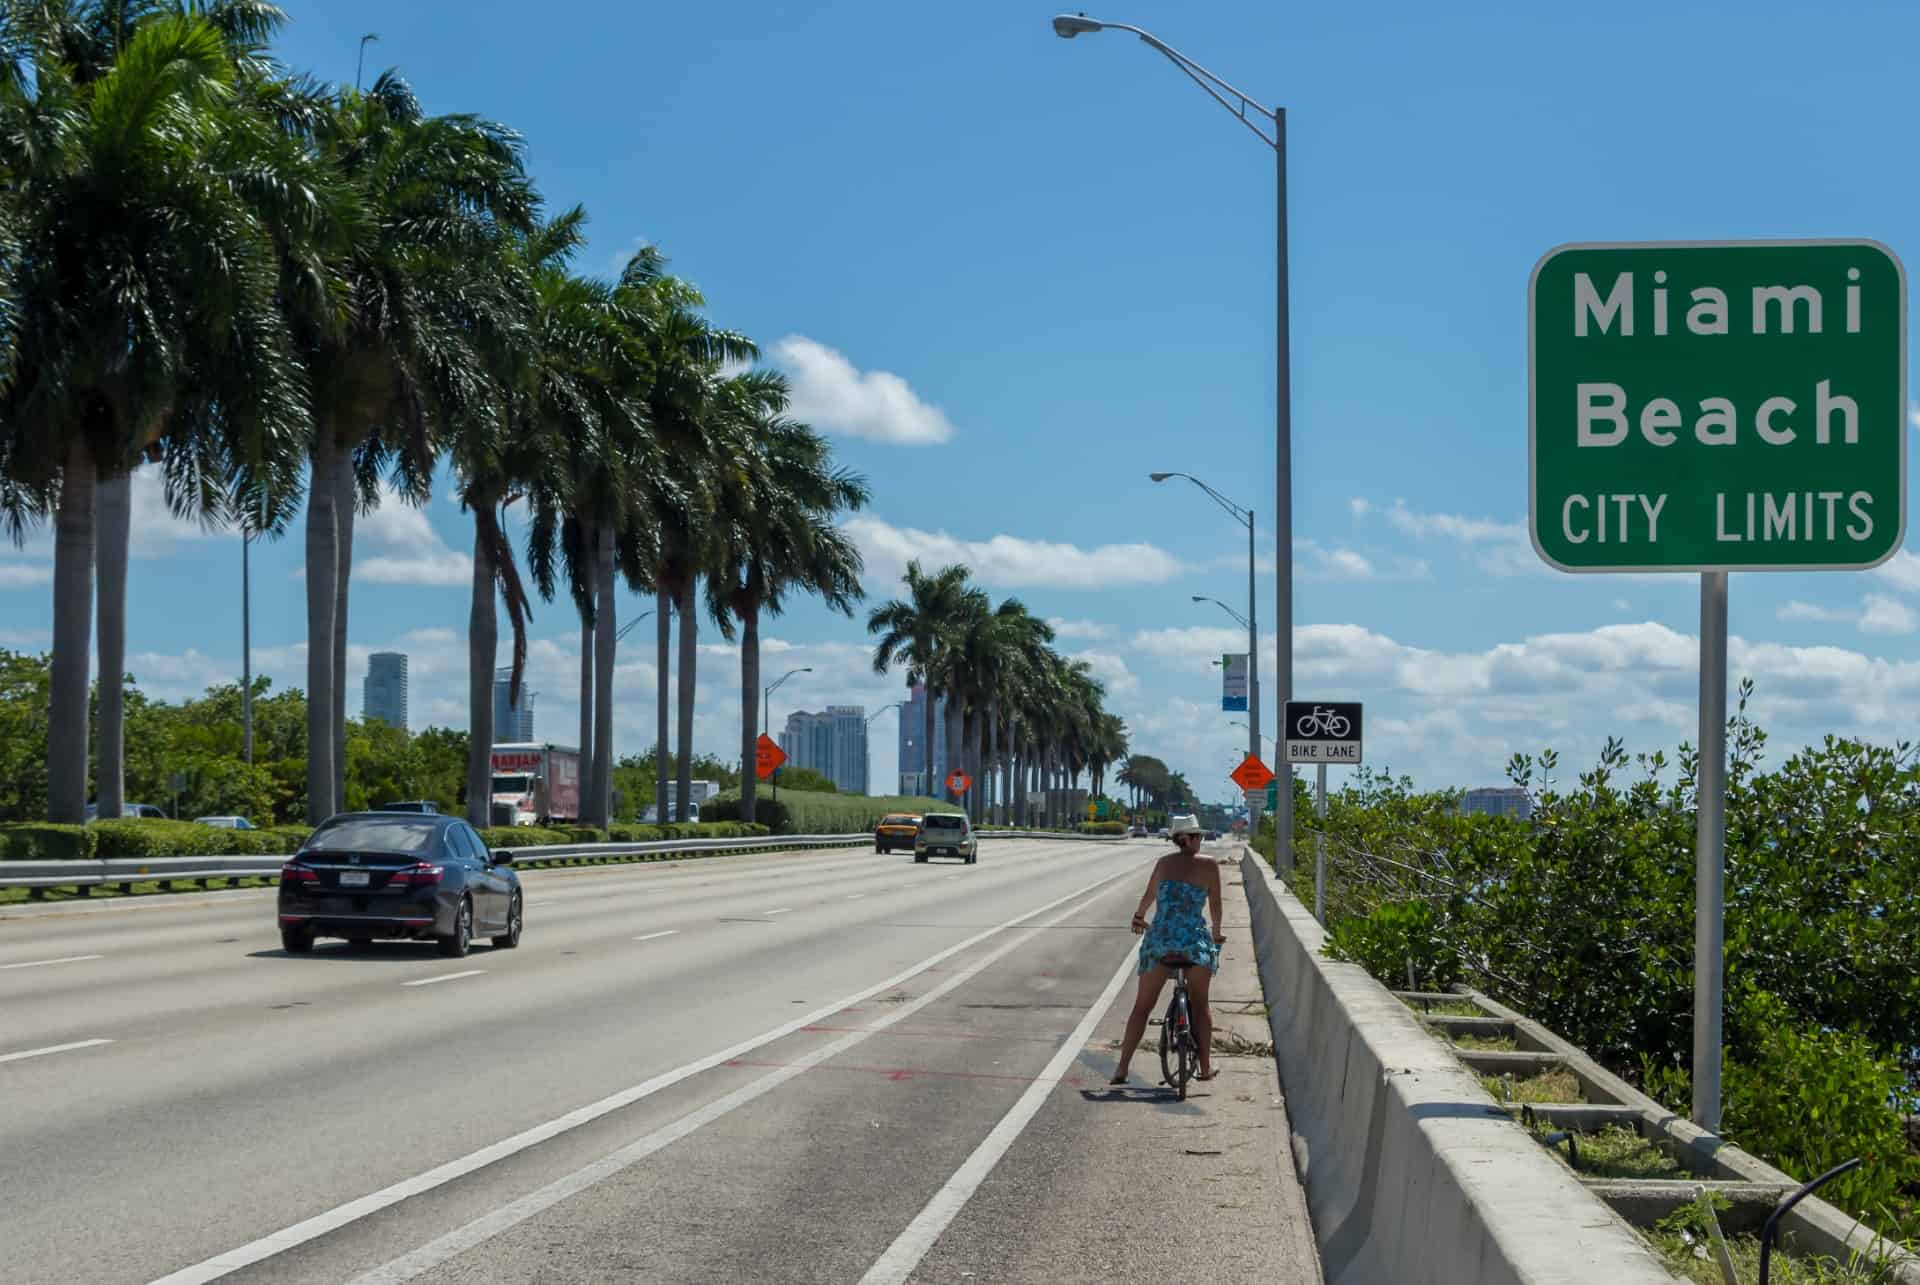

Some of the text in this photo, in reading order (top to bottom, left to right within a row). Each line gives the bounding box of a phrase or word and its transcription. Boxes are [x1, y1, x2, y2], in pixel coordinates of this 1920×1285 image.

[1574, 267, 1861, 337] Miami
[1577, 379, 1859, 448] Beach
[1562, 491, 1874, 544] CITY LIMITS
[1291, 745, 1355, 757] BIKE LANE
